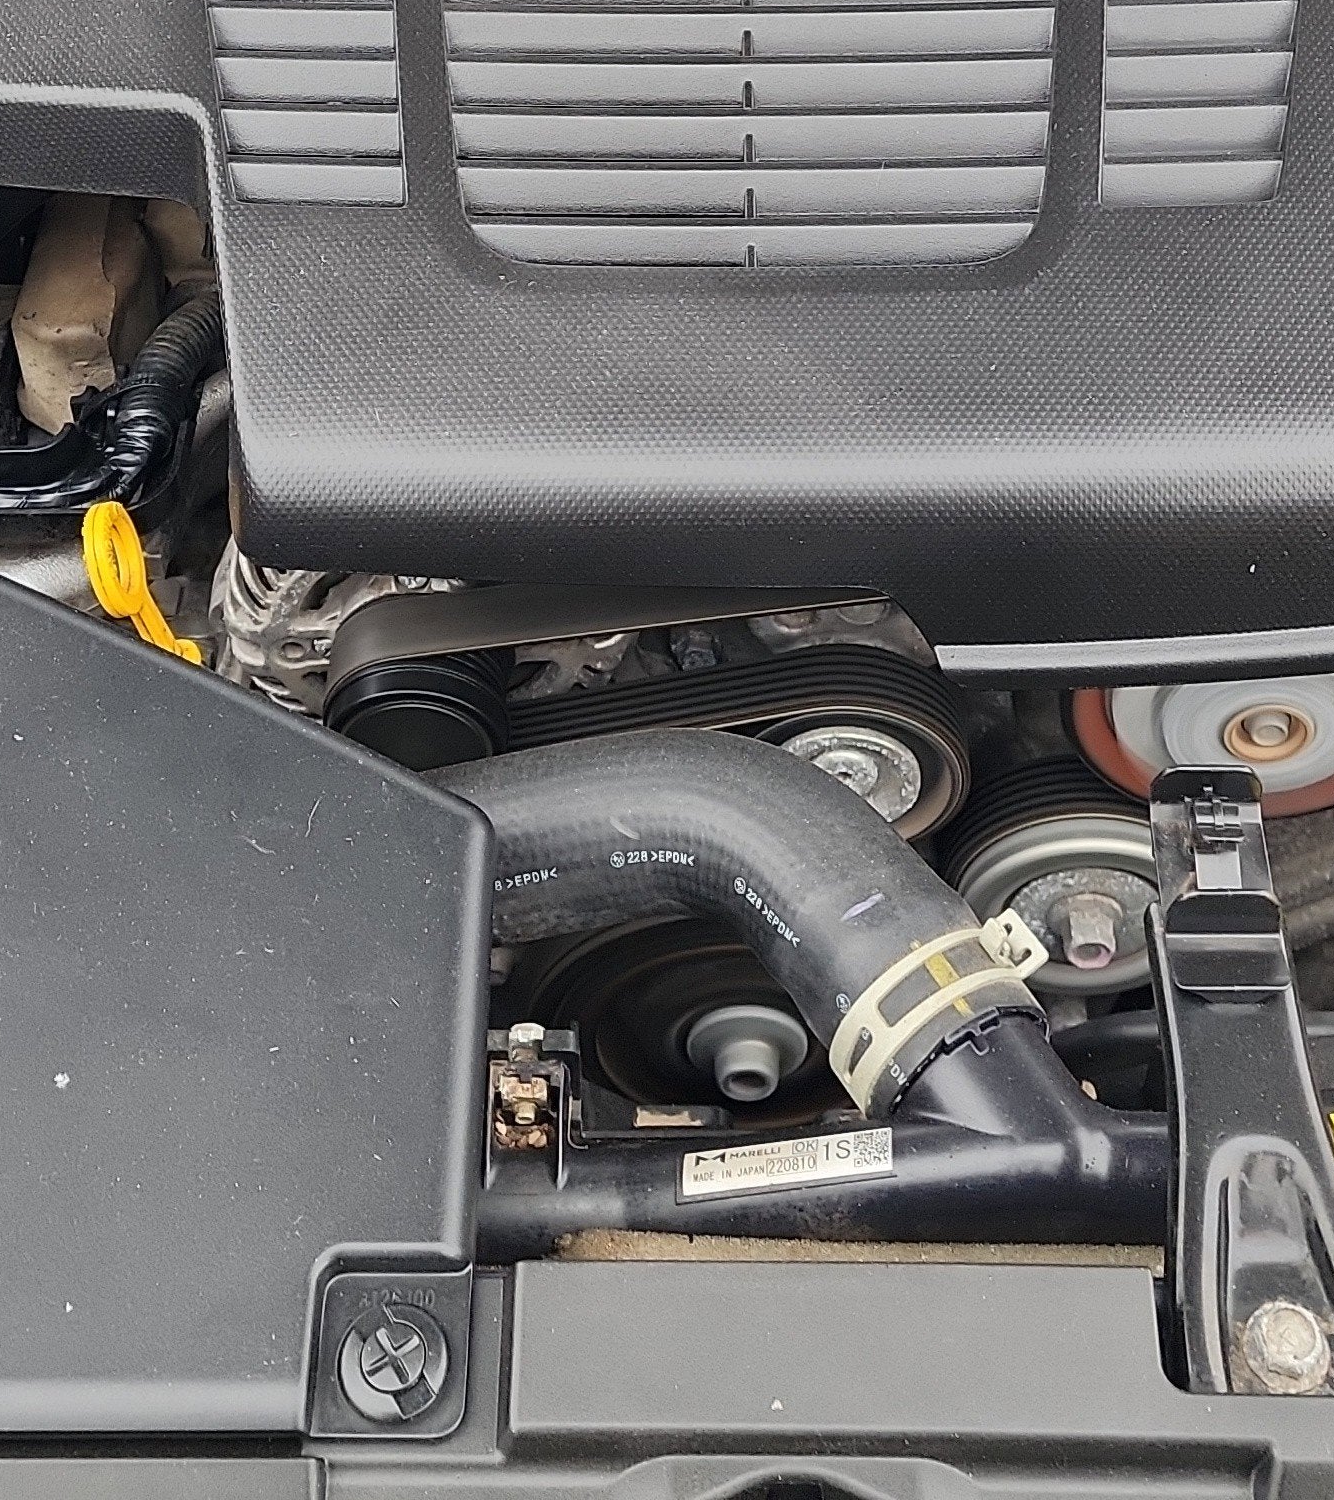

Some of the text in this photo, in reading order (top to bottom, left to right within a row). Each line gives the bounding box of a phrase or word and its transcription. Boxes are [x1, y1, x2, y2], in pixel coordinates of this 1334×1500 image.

[626, 850, 649, 864] 228
[745, 887, 762, 910] 228
[729, 1141, 816, 1160] MARELLI OK
[823, 1139, 851, 1161] 1S
[692, 1155, 816, 1183] MADE IN JAPAN 220810
